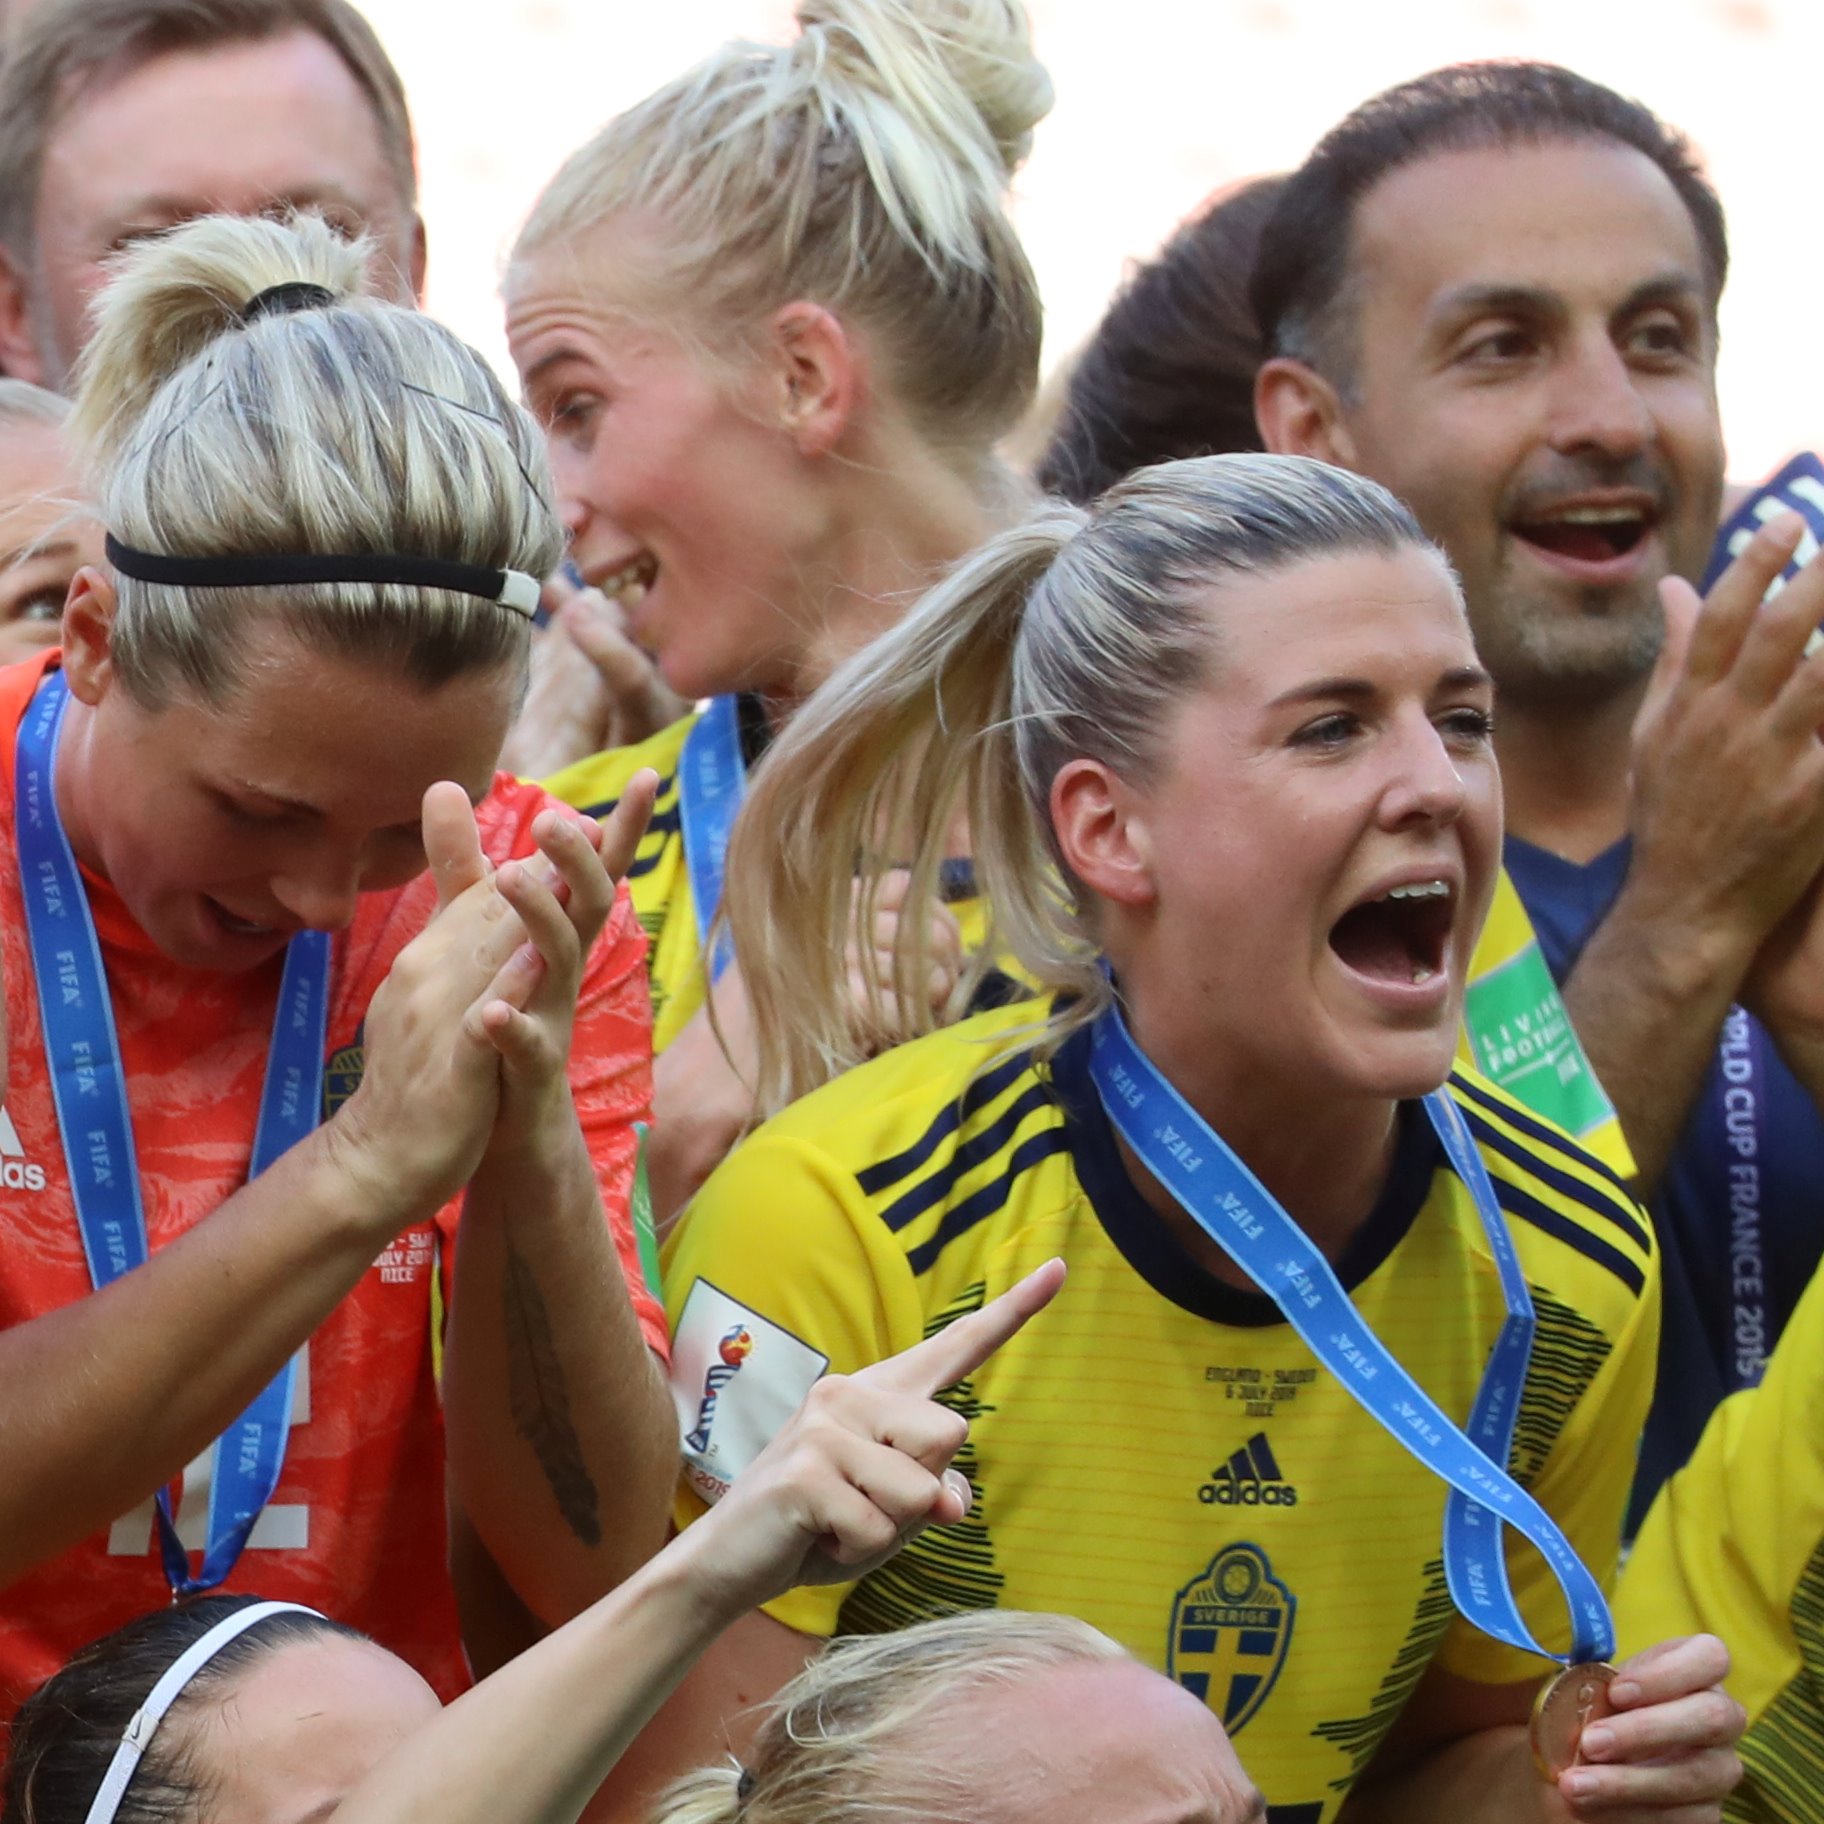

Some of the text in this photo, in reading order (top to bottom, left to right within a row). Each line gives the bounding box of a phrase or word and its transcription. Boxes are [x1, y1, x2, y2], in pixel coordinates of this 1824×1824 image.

[37, 861, 61, 917] FIFA
[56, 951, 80, 1005] FIFA
[70, 1040, 98, 1096] FIFA
[88, 1132, 113, 1184] FIFA
[1725, 1090, 1754, 1156] CUP
[1729, 1166, 1761, 1296] FRANCE
[381, 1267, 414, 1283] NICE
[1162, 1126, 1201, 1173] FIFA
[1223, 1192, 1264, 1240] FIFA
[1289, 1262, 1320, 1308] FIFA
[1339, 1333, 1378, 1381] FIFA
[1402, 1401, 1442, 1446] FIFA
[1470, 1466, 1514, 1505] FIFA
[1198, 1479, 1296, 1505] adidas
[1193, 1607, 1271, 1626] SVERIGE
